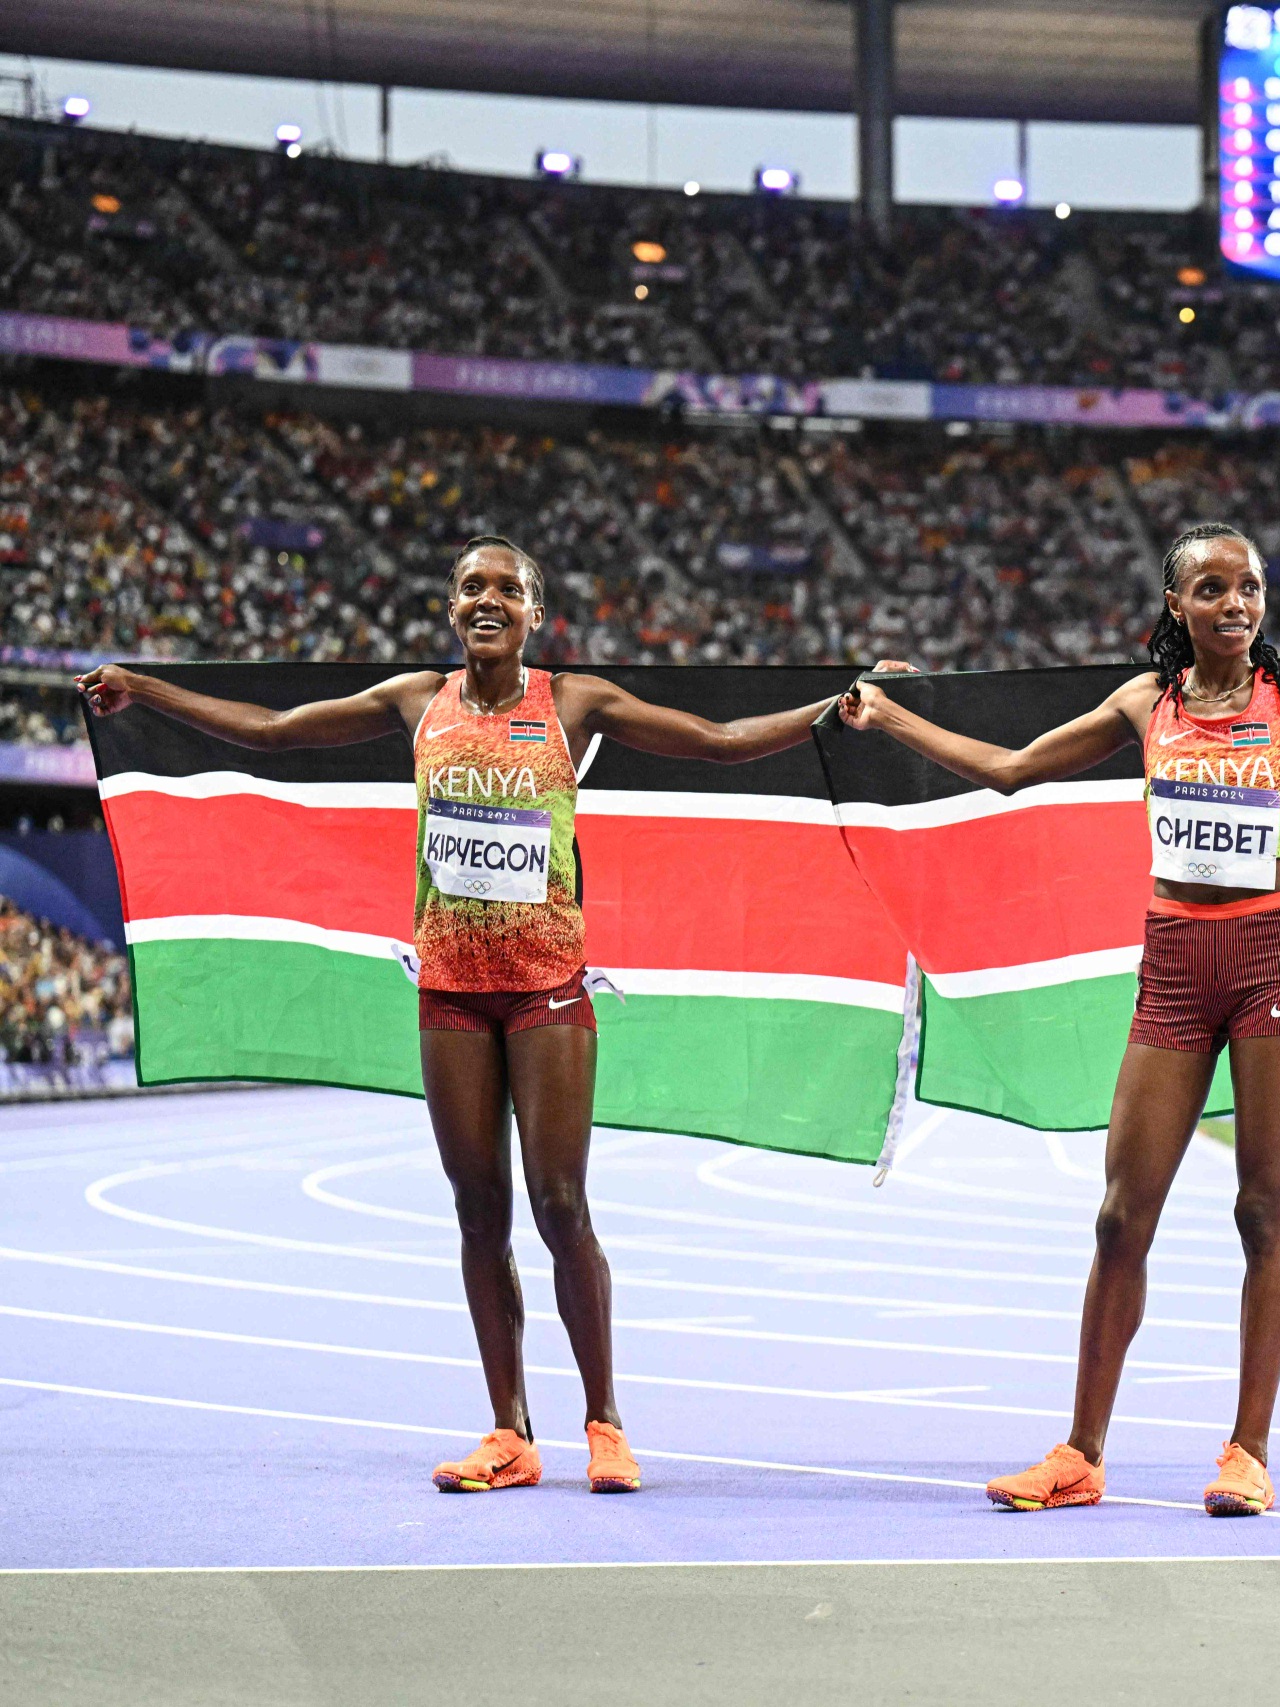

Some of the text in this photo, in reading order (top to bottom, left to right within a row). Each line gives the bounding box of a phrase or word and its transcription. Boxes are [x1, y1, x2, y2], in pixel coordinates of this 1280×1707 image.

[429, 766, 537, 799] KENYA
[1155, 756, 1276, 788] KENYA
[1175, 785, 1244, 800] PARIS 2024
[452, 805, 517, 821] PARIS 2024
[1156, 815, 1273, 855] CHEBET
[427, 832, 546, 873] KIPYEGON
